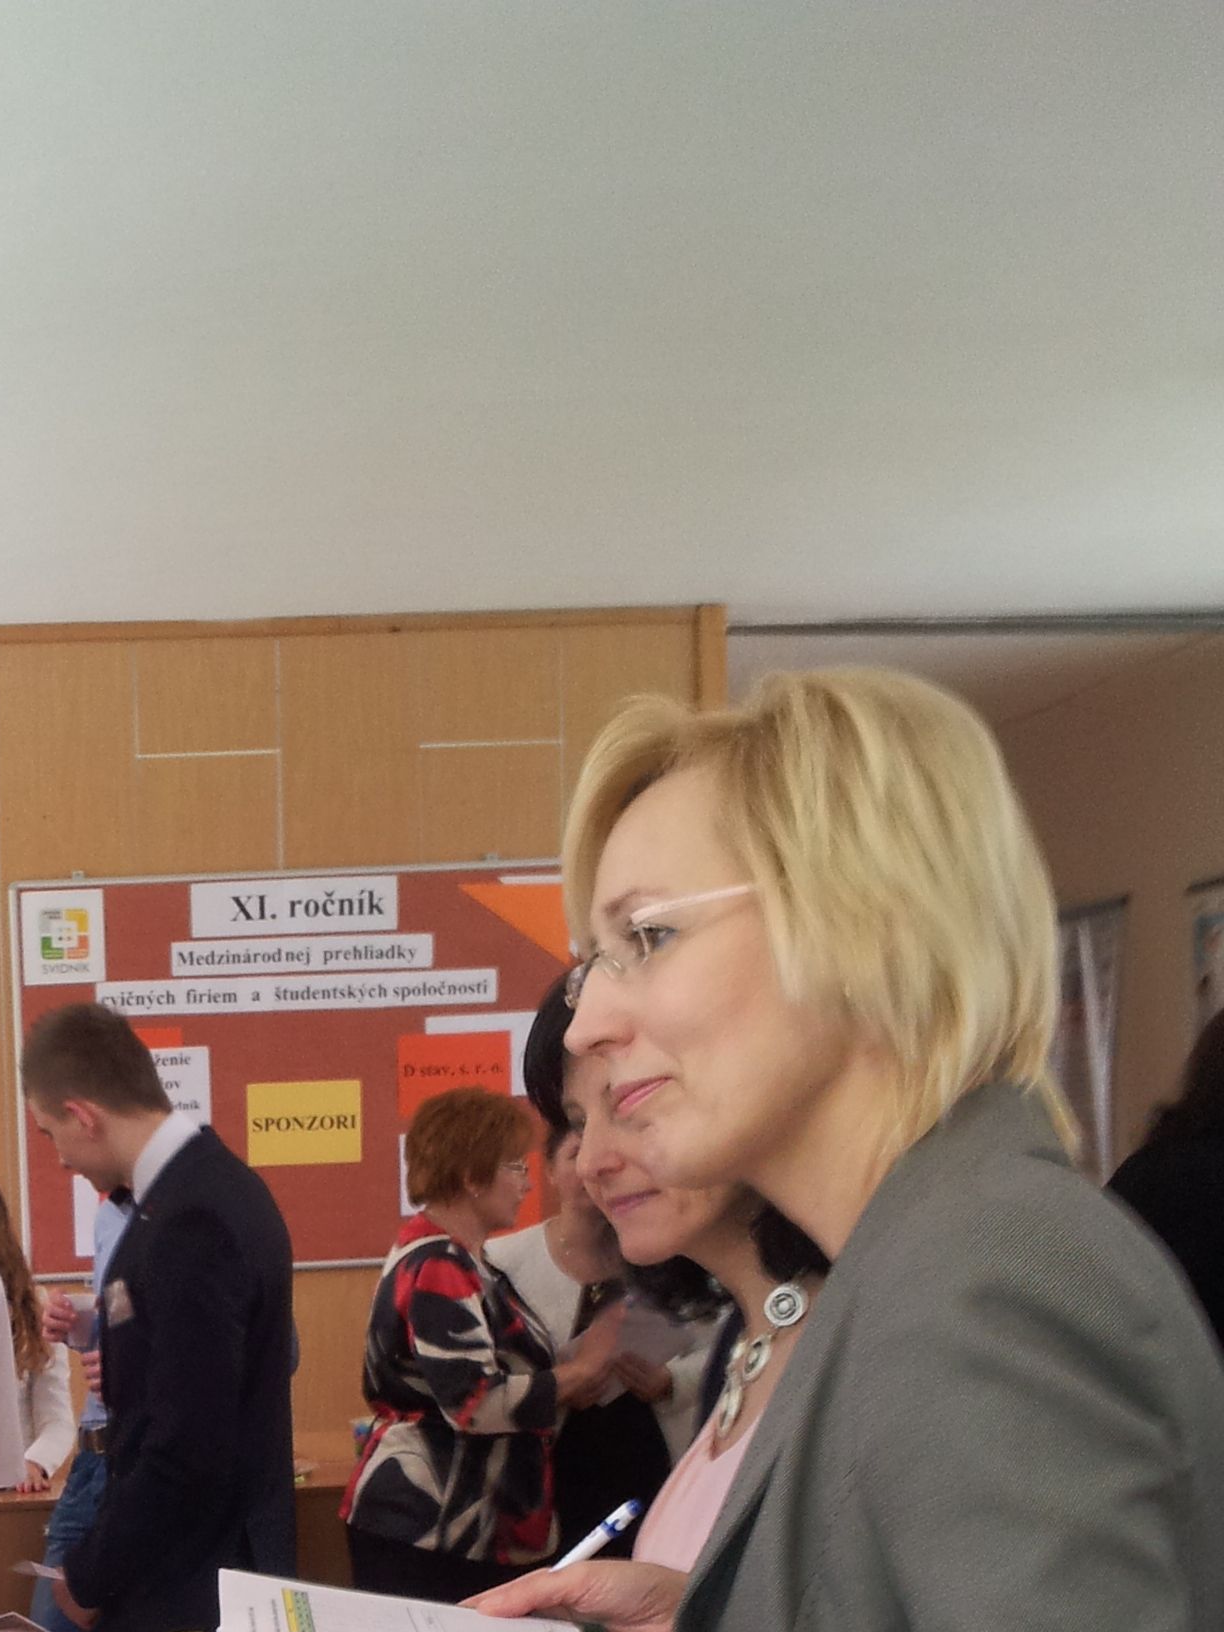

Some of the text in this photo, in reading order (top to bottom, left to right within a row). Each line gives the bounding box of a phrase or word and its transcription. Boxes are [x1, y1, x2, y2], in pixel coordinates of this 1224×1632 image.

[230, 889, 385, 922] XI. ročník
[323, 943, 417, 964] prehliadky
[186, 988, 237, 1004] firiem
[251, 992, 261, 1002] a
[274, 983, 387, 1002] študentských
[252, 1114, 356, 1133] SPONZORI
